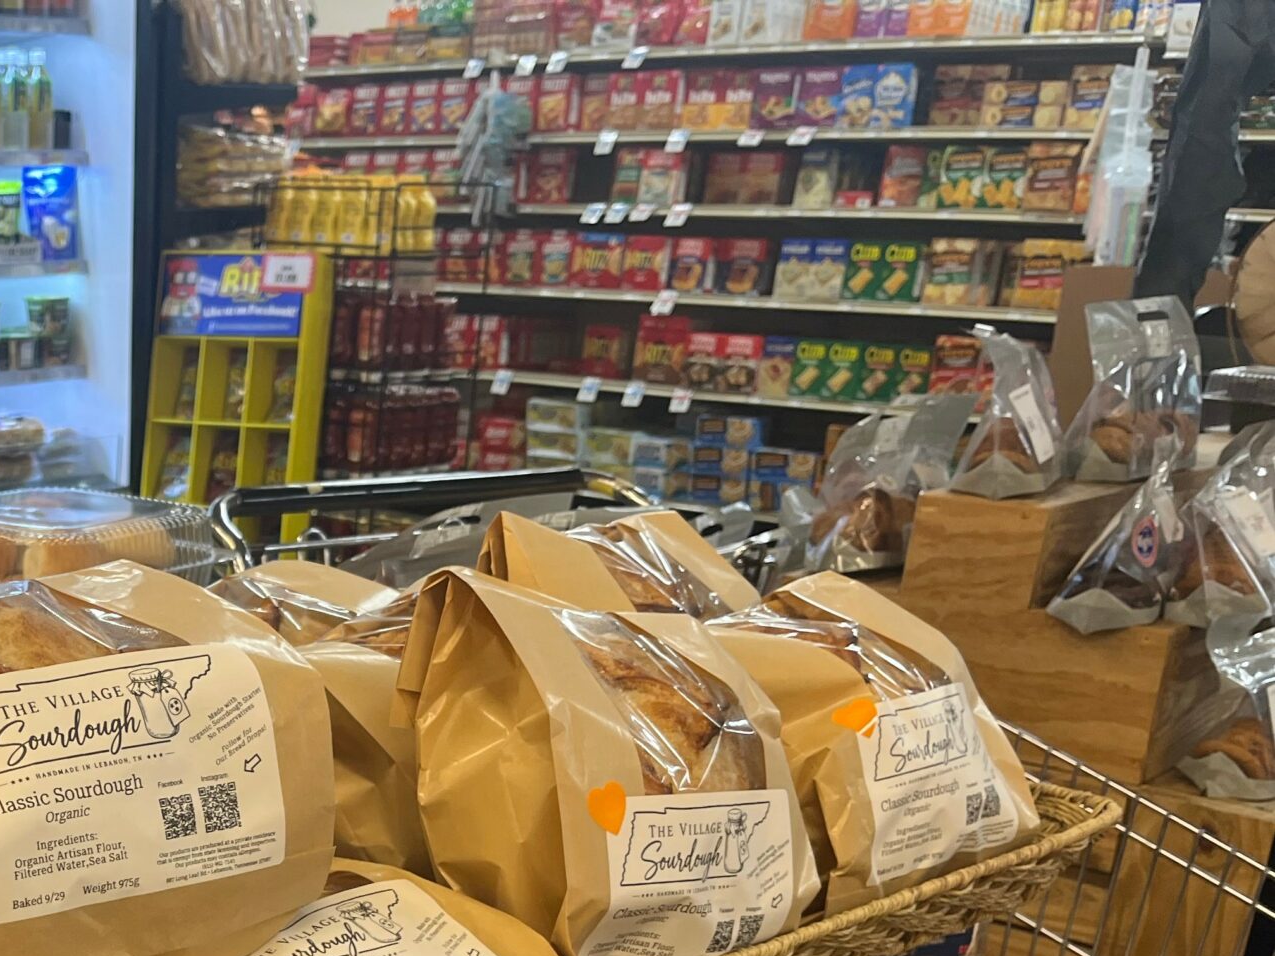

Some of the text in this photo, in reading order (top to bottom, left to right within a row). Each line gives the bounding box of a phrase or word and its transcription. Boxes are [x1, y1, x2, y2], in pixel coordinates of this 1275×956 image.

[45, 685, 124, 710] VILLAGE
[53, 774, 143, 804] Sourdough
[45, 805, 90, 824] Organic
[36, 832, 98, 852] Ingredients:
[648, 822, 722, 838] THE VILLAGE
[14, 840, 126, 869] Organic Artisan Flour,
[14, 865, 53, 880] Filtered
[109, 850, 128, 862] Salt
[641, 837, 722, 883] Sourdough
[12, 877, 140, 909] Baked 9/29 Weight 975g
[277, 916, 340, 946] VILLAGE
